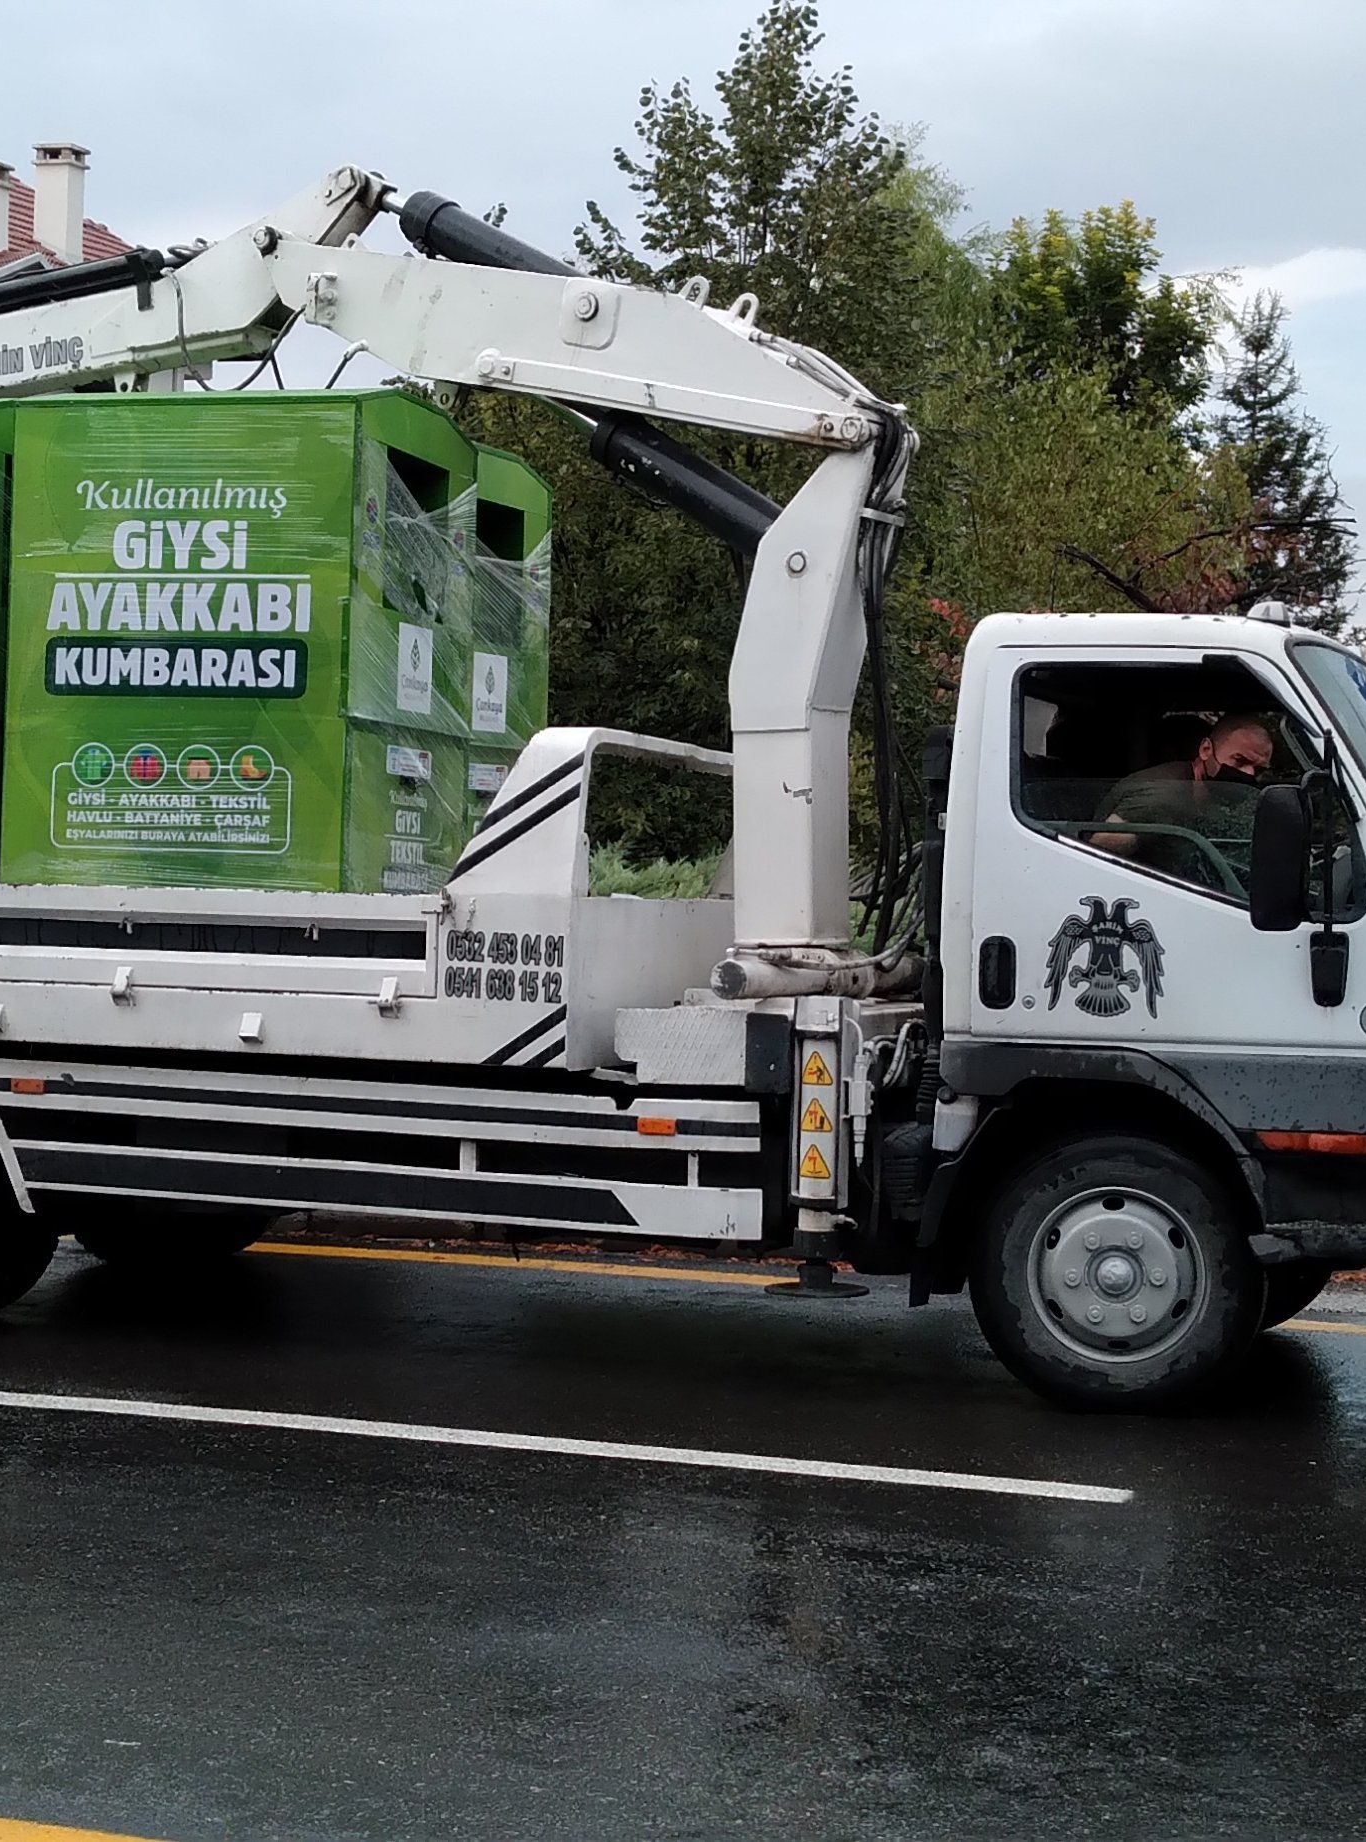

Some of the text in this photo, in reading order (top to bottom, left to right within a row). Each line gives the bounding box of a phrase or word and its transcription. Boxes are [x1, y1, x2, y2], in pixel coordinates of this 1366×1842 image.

[30, 336, 84, 369] VİNÇ
[76, 478, 288, 518] Kullanılmış
[46, 582, 311, 633] AYAKKABI
[55, 646, 296, 688] KUMBARASI
[67, 810, 113, 823] HAVLU
[124, 809, 202, 826] BATTANİYE
[118, 794, 196, 808] AYAKKABI
[210, 792, 271, 810] TEKSTİL
[141, 830, 186, 842] BURAYA
[446, 929, 564, 967] 0532 453 04 81
[444, 966, 562, 1004] 0541 638 15 12
